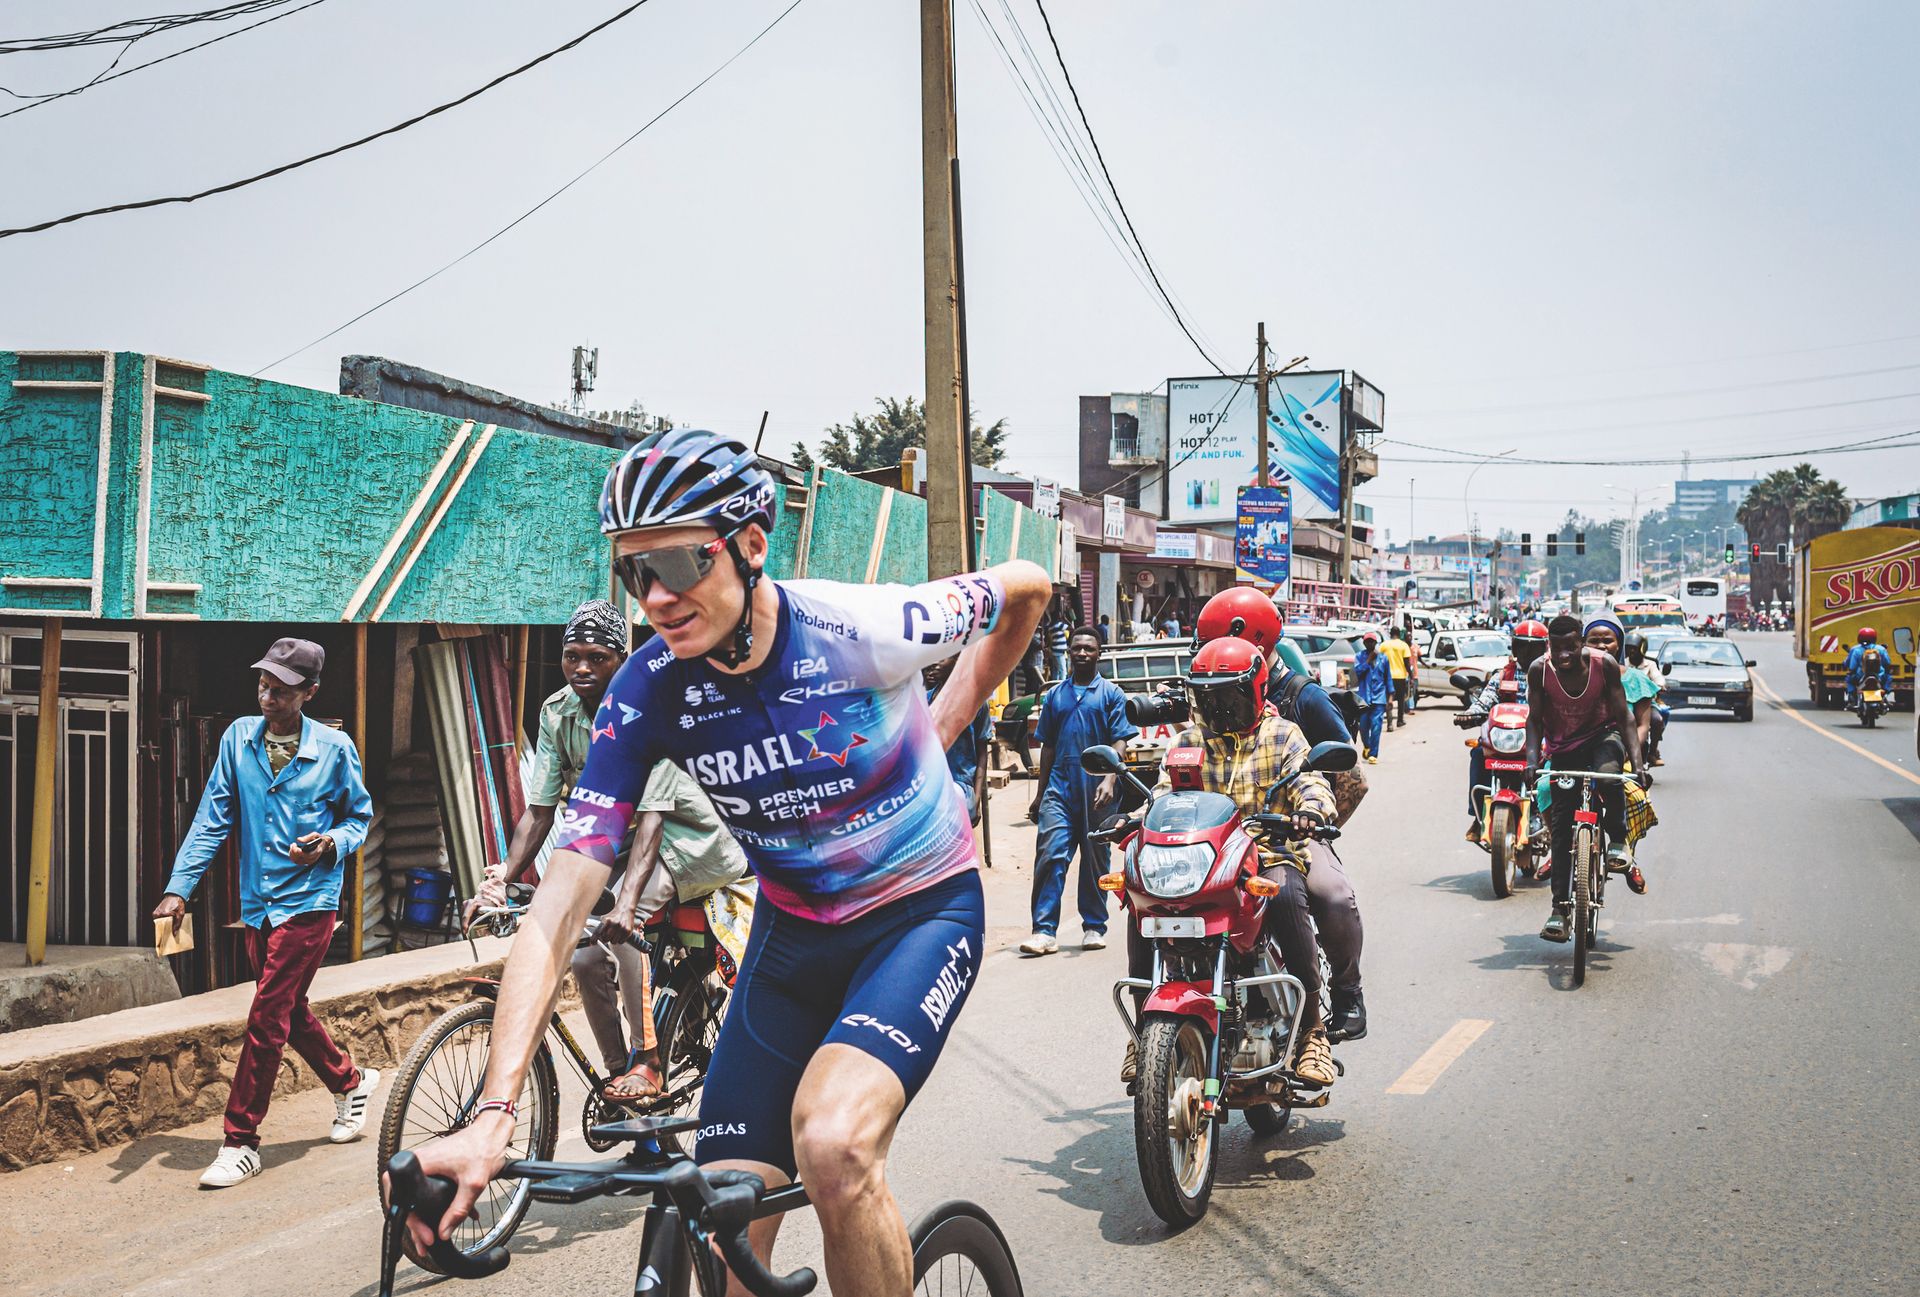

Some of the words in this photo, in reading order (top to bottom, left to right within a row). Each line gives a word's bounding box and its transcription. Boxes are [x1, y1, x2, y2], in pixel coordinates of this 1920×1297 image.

[1189, 412, 1214, 424] HOT
[1217, 412, 1229, 423] 12
[1180, 437, 1206, 448] HOT
[1208, 437, 1220, 448] 12
[1175, 451, 1200, 460] FAST
[1201, 450, 1220, 460] AND
[1223, 450, 1246, 459] FUN.
[795, 608, 845, 636] Roland
[793, 656, 830, 680] i24
[708, 694, 725, 703] TEAM
[697, 712, 725, 722] BLACK
[727, 707, 743, 716] INC
[686, 734, 804, 786] ISRAEL
[759, 777, 856, 811] PREMIER
[763, 802, 822, 823] TECH
[919, 965, 961, 1033] ISRAEL
